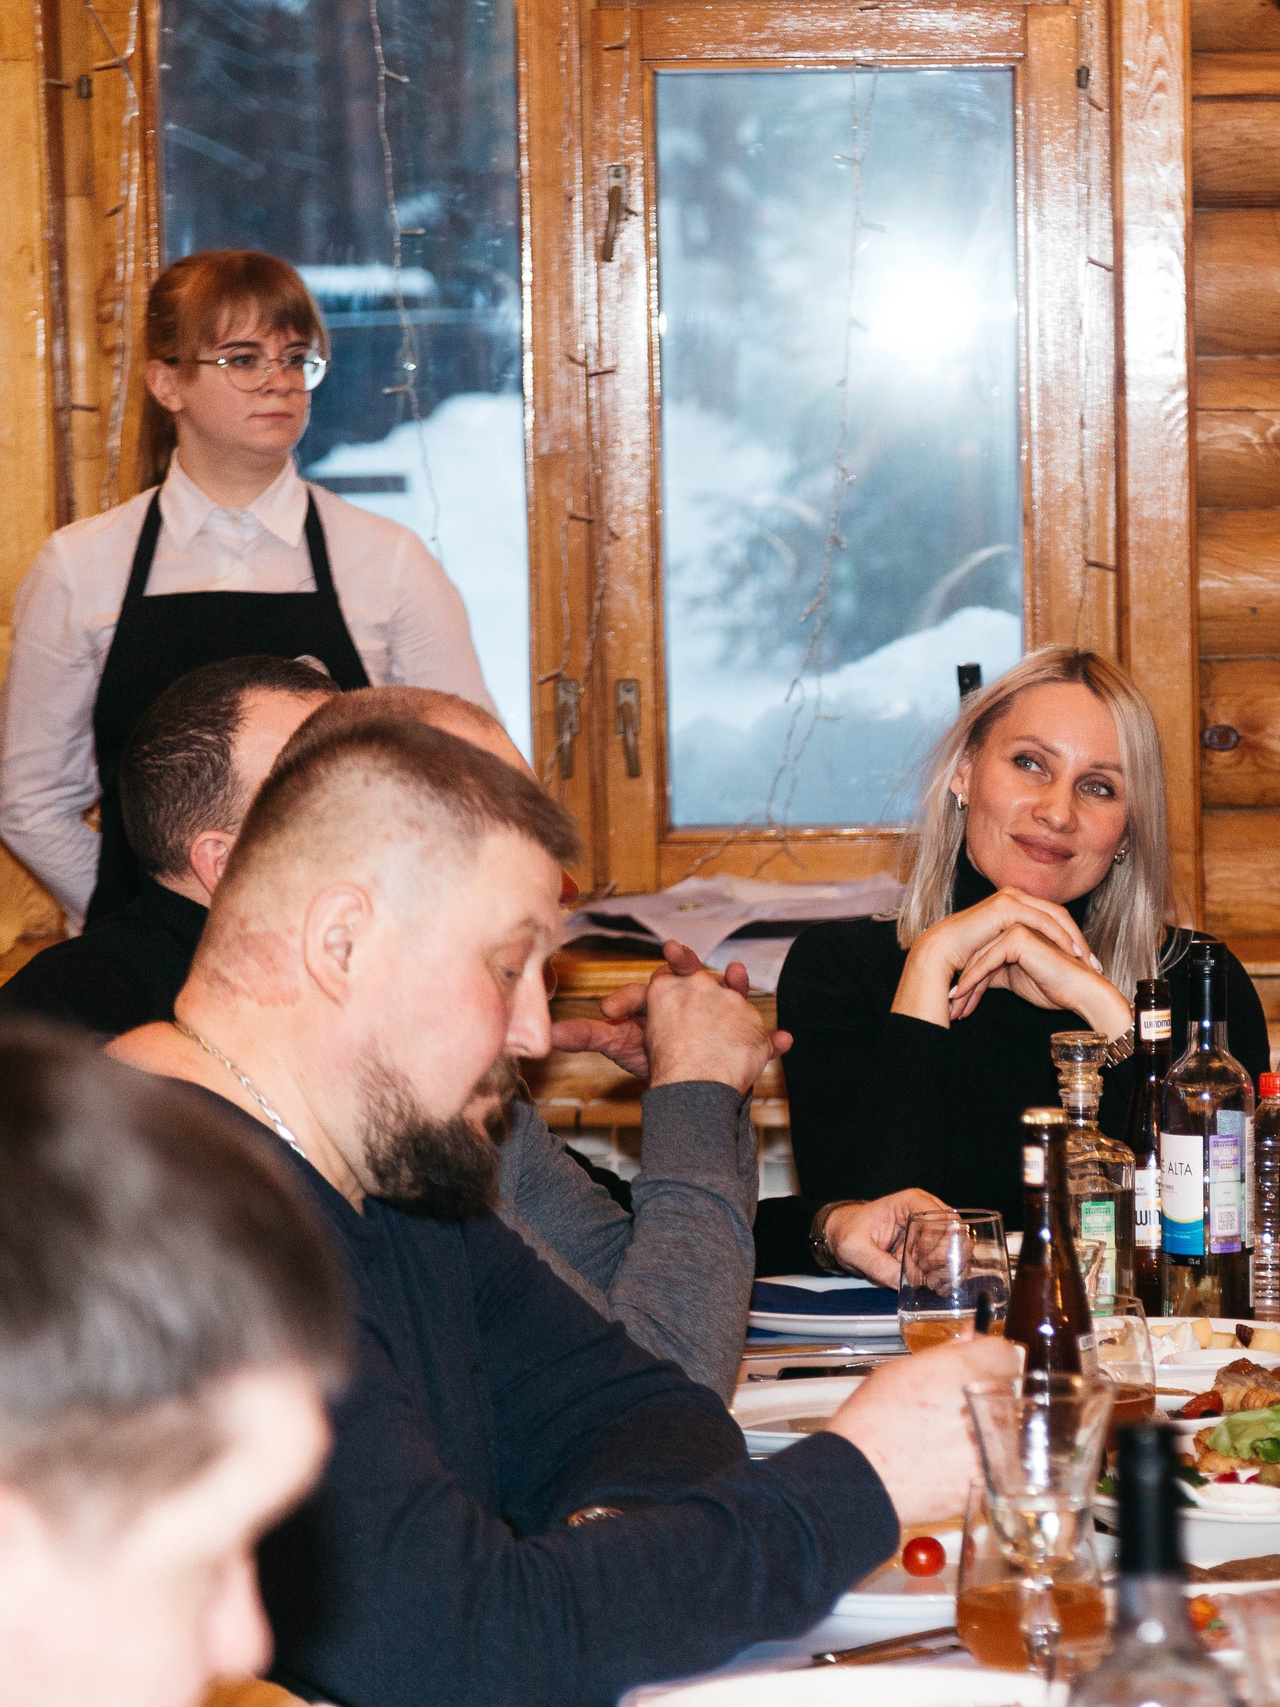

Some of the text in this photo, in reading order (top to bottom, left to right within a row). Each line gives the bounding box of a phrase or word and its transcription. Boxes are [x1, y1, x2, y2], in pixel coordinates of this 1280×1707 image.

[1144, 1018, 1171, 1029] WINDMO
[1167, 1161, 1193, 1176] ALTA
[1135, 1210, 1161, 1226] WIN
